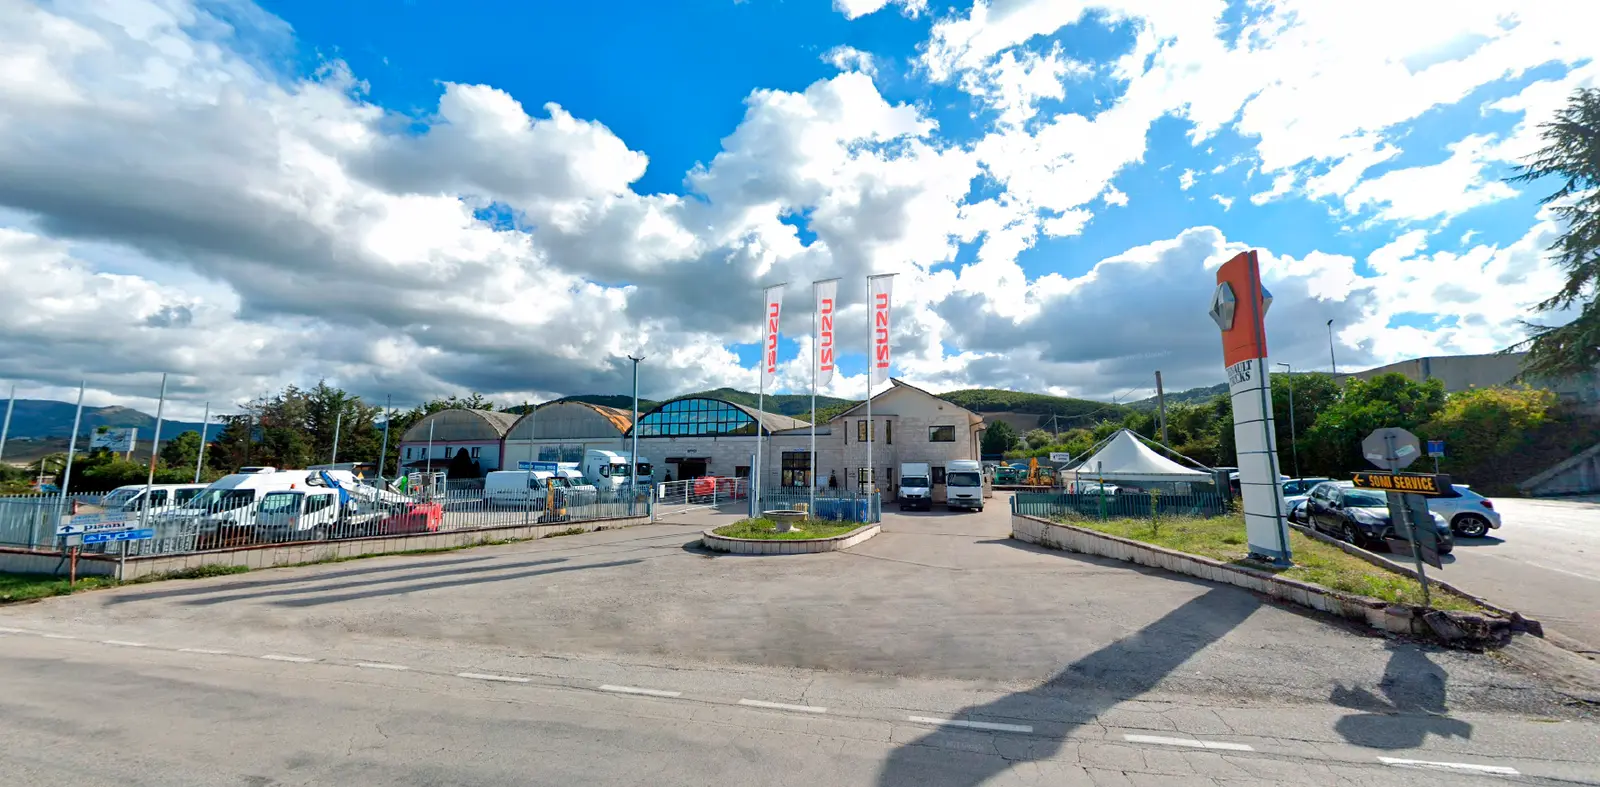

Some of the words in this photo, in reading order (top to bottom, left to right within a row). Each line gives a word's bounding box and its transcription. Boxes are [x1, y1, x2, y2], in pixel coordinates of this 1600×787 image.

[768, 303, 779, 373] ISUZU
[821, 298, 833, 371] ISUZU
[876, 293, 889, 368] ISUZU
[1225, 360, 1252, 377] NAULT
[1229, 371, 1250, 387] UCKS
[1369, 475, 1392, 488] SOMI
[1393, 477, 1435, 490] SERVICE
